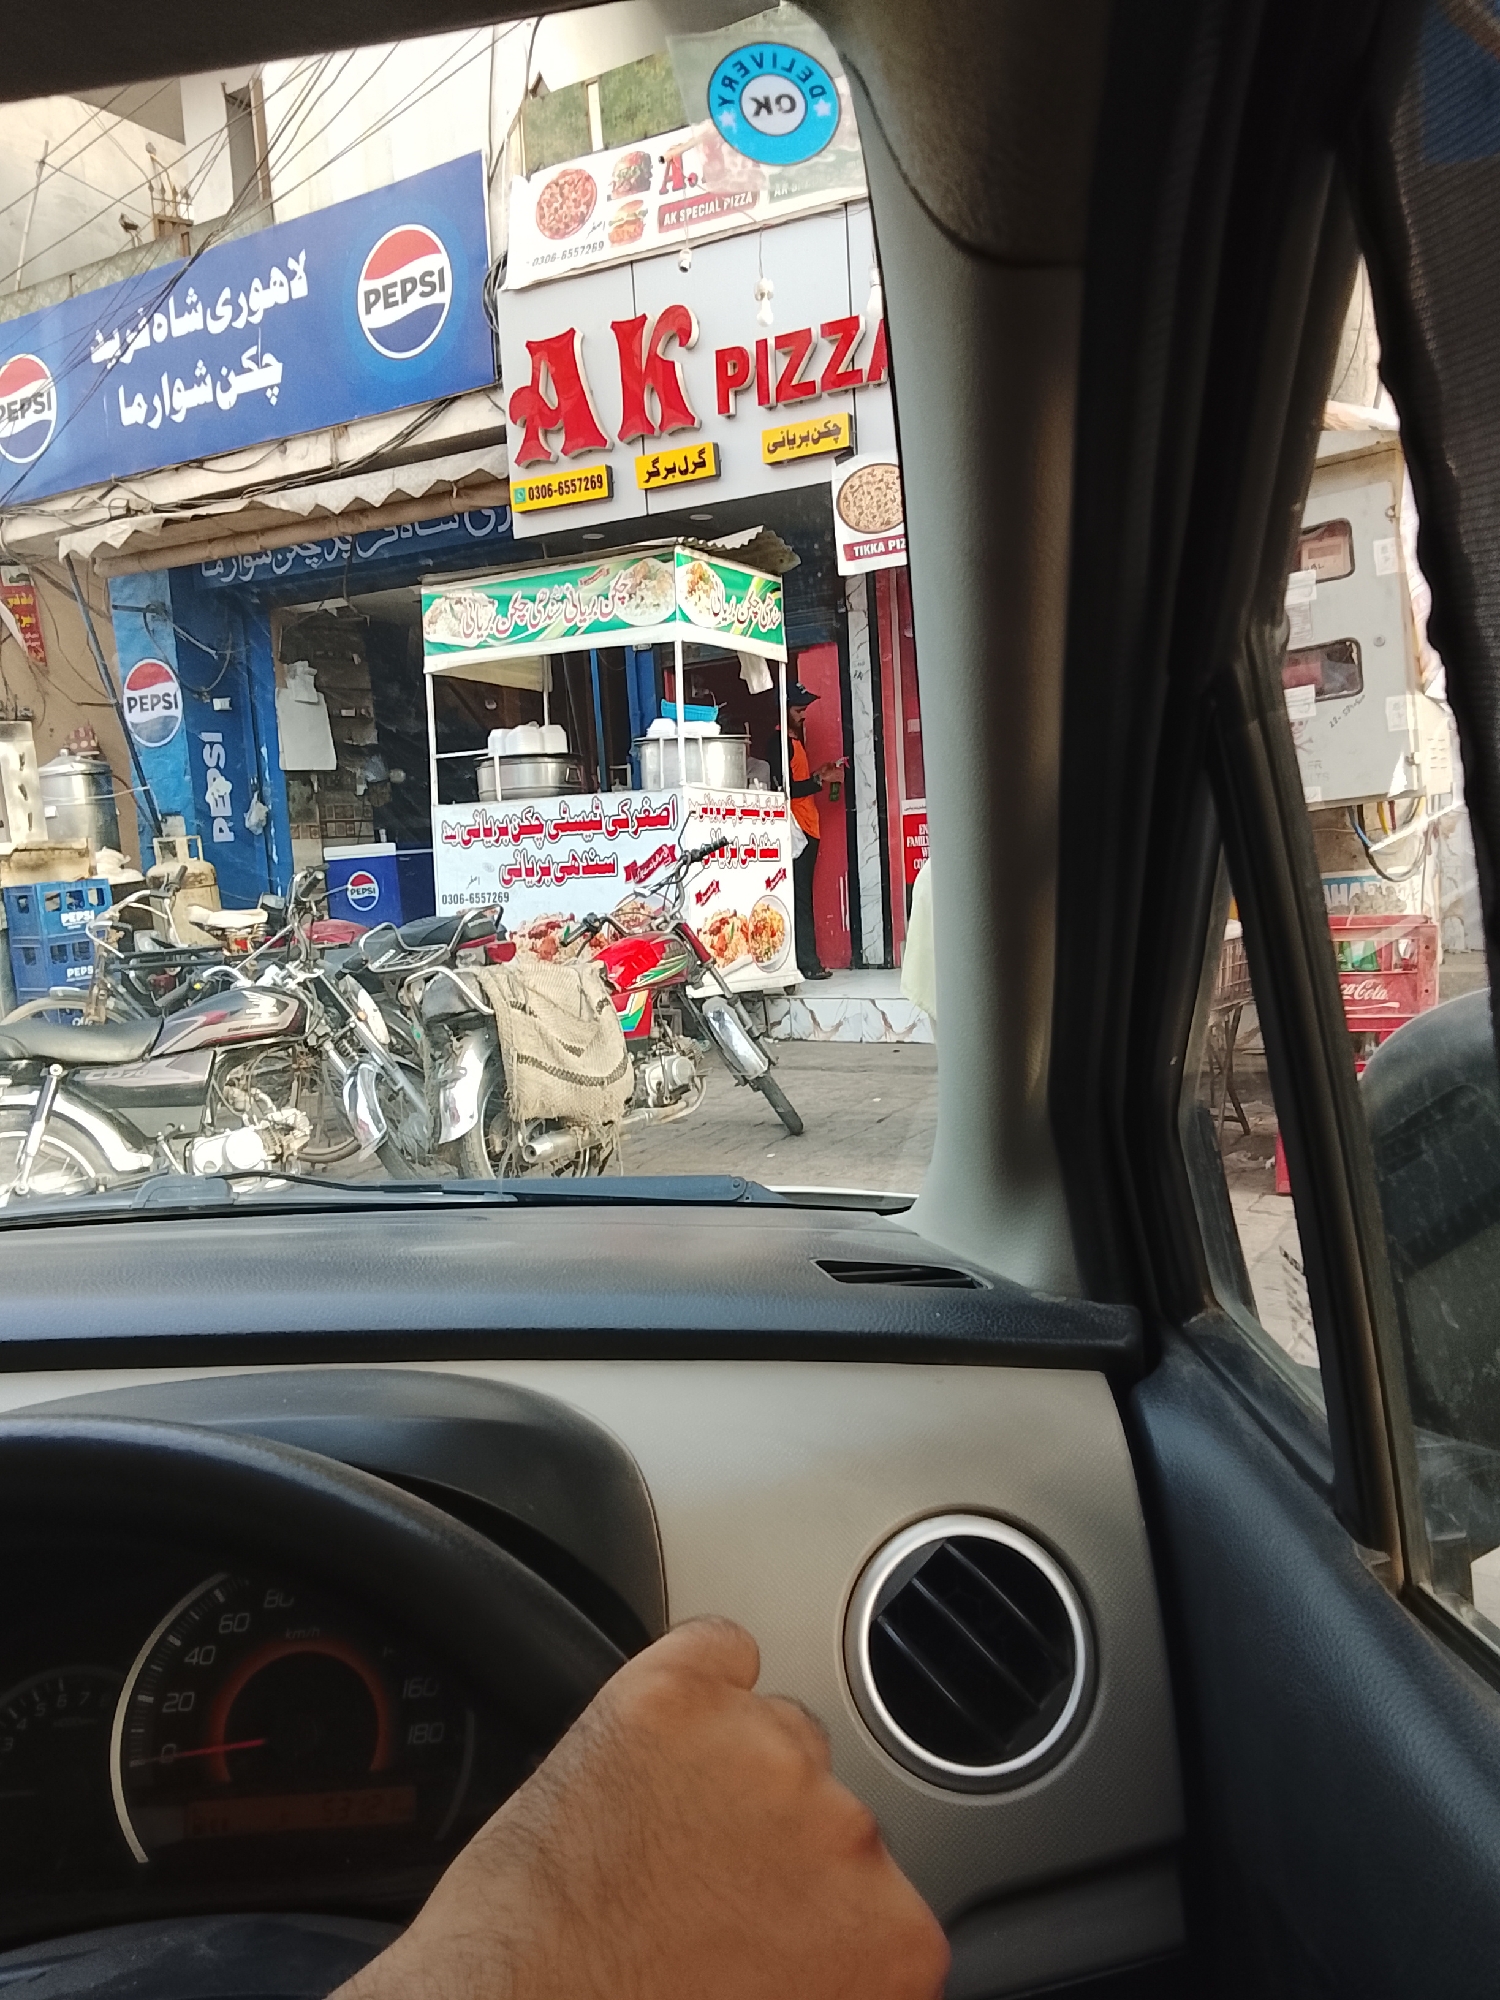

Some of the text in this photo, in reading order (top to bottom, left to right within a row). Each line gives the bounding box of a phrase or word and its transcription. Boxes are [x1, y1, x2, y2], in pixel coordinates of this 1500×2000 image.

[663, 191, 753, 227] AK SPECIAL PIZZA
[363, 270, 446, 315] PEPSI
[118, 344, 284, 429] چکن شوارما
[508, 304, 701, 468] AK
[767, 419, 843, 454] چکن بریانی
[527, 474, 604, 501] 0306-6557269
[853, 537, 907, 557] TIKKA PIZ
[127, 692, 180, 714] PEPSI
[199, 732, 236, 843] PEPSI
[461, 808, 510, 848] بریانی
[508, 805, 548, 849] چکن
[499, 848, 554, 888] بریانی
[350, 887, 376, 896] PEPSI
[442, 892, 509, 905] 0306-6557269
[60, 910, 95, 925] PEPSI
[66, 965, 94, 979] PEPS
[218, 1612, 251, 1635] 60
[184, 1645, 216, 1666] 40
[402, 1677, 440, 1700] 160
[161, 1691, 195, 1713] 20
[407, 1721, 445, 1745] 180
